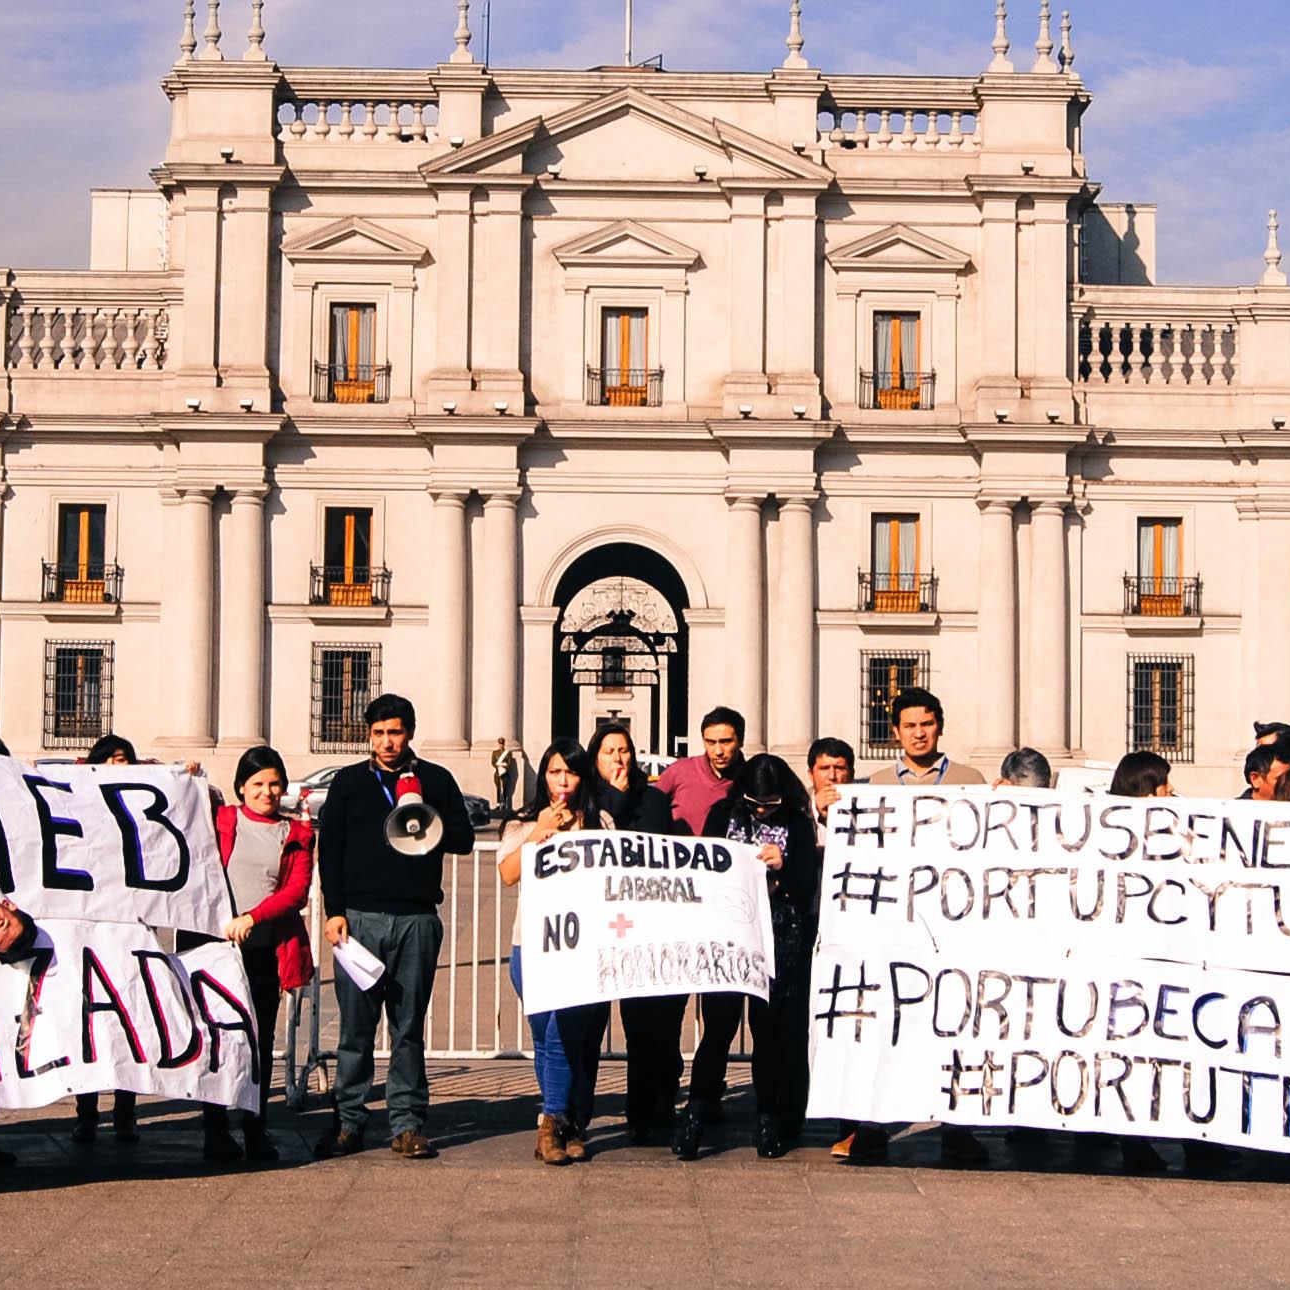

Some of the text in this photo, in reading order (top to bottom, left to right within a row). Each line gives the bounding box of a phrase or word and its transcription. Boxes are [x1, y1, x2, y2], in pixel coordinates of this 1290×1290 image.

[605, 875, 703, 903] LABORAL
[542, 911, 580, 953] NO
[815, 960, 1282, 1057] #PORTUBECA
